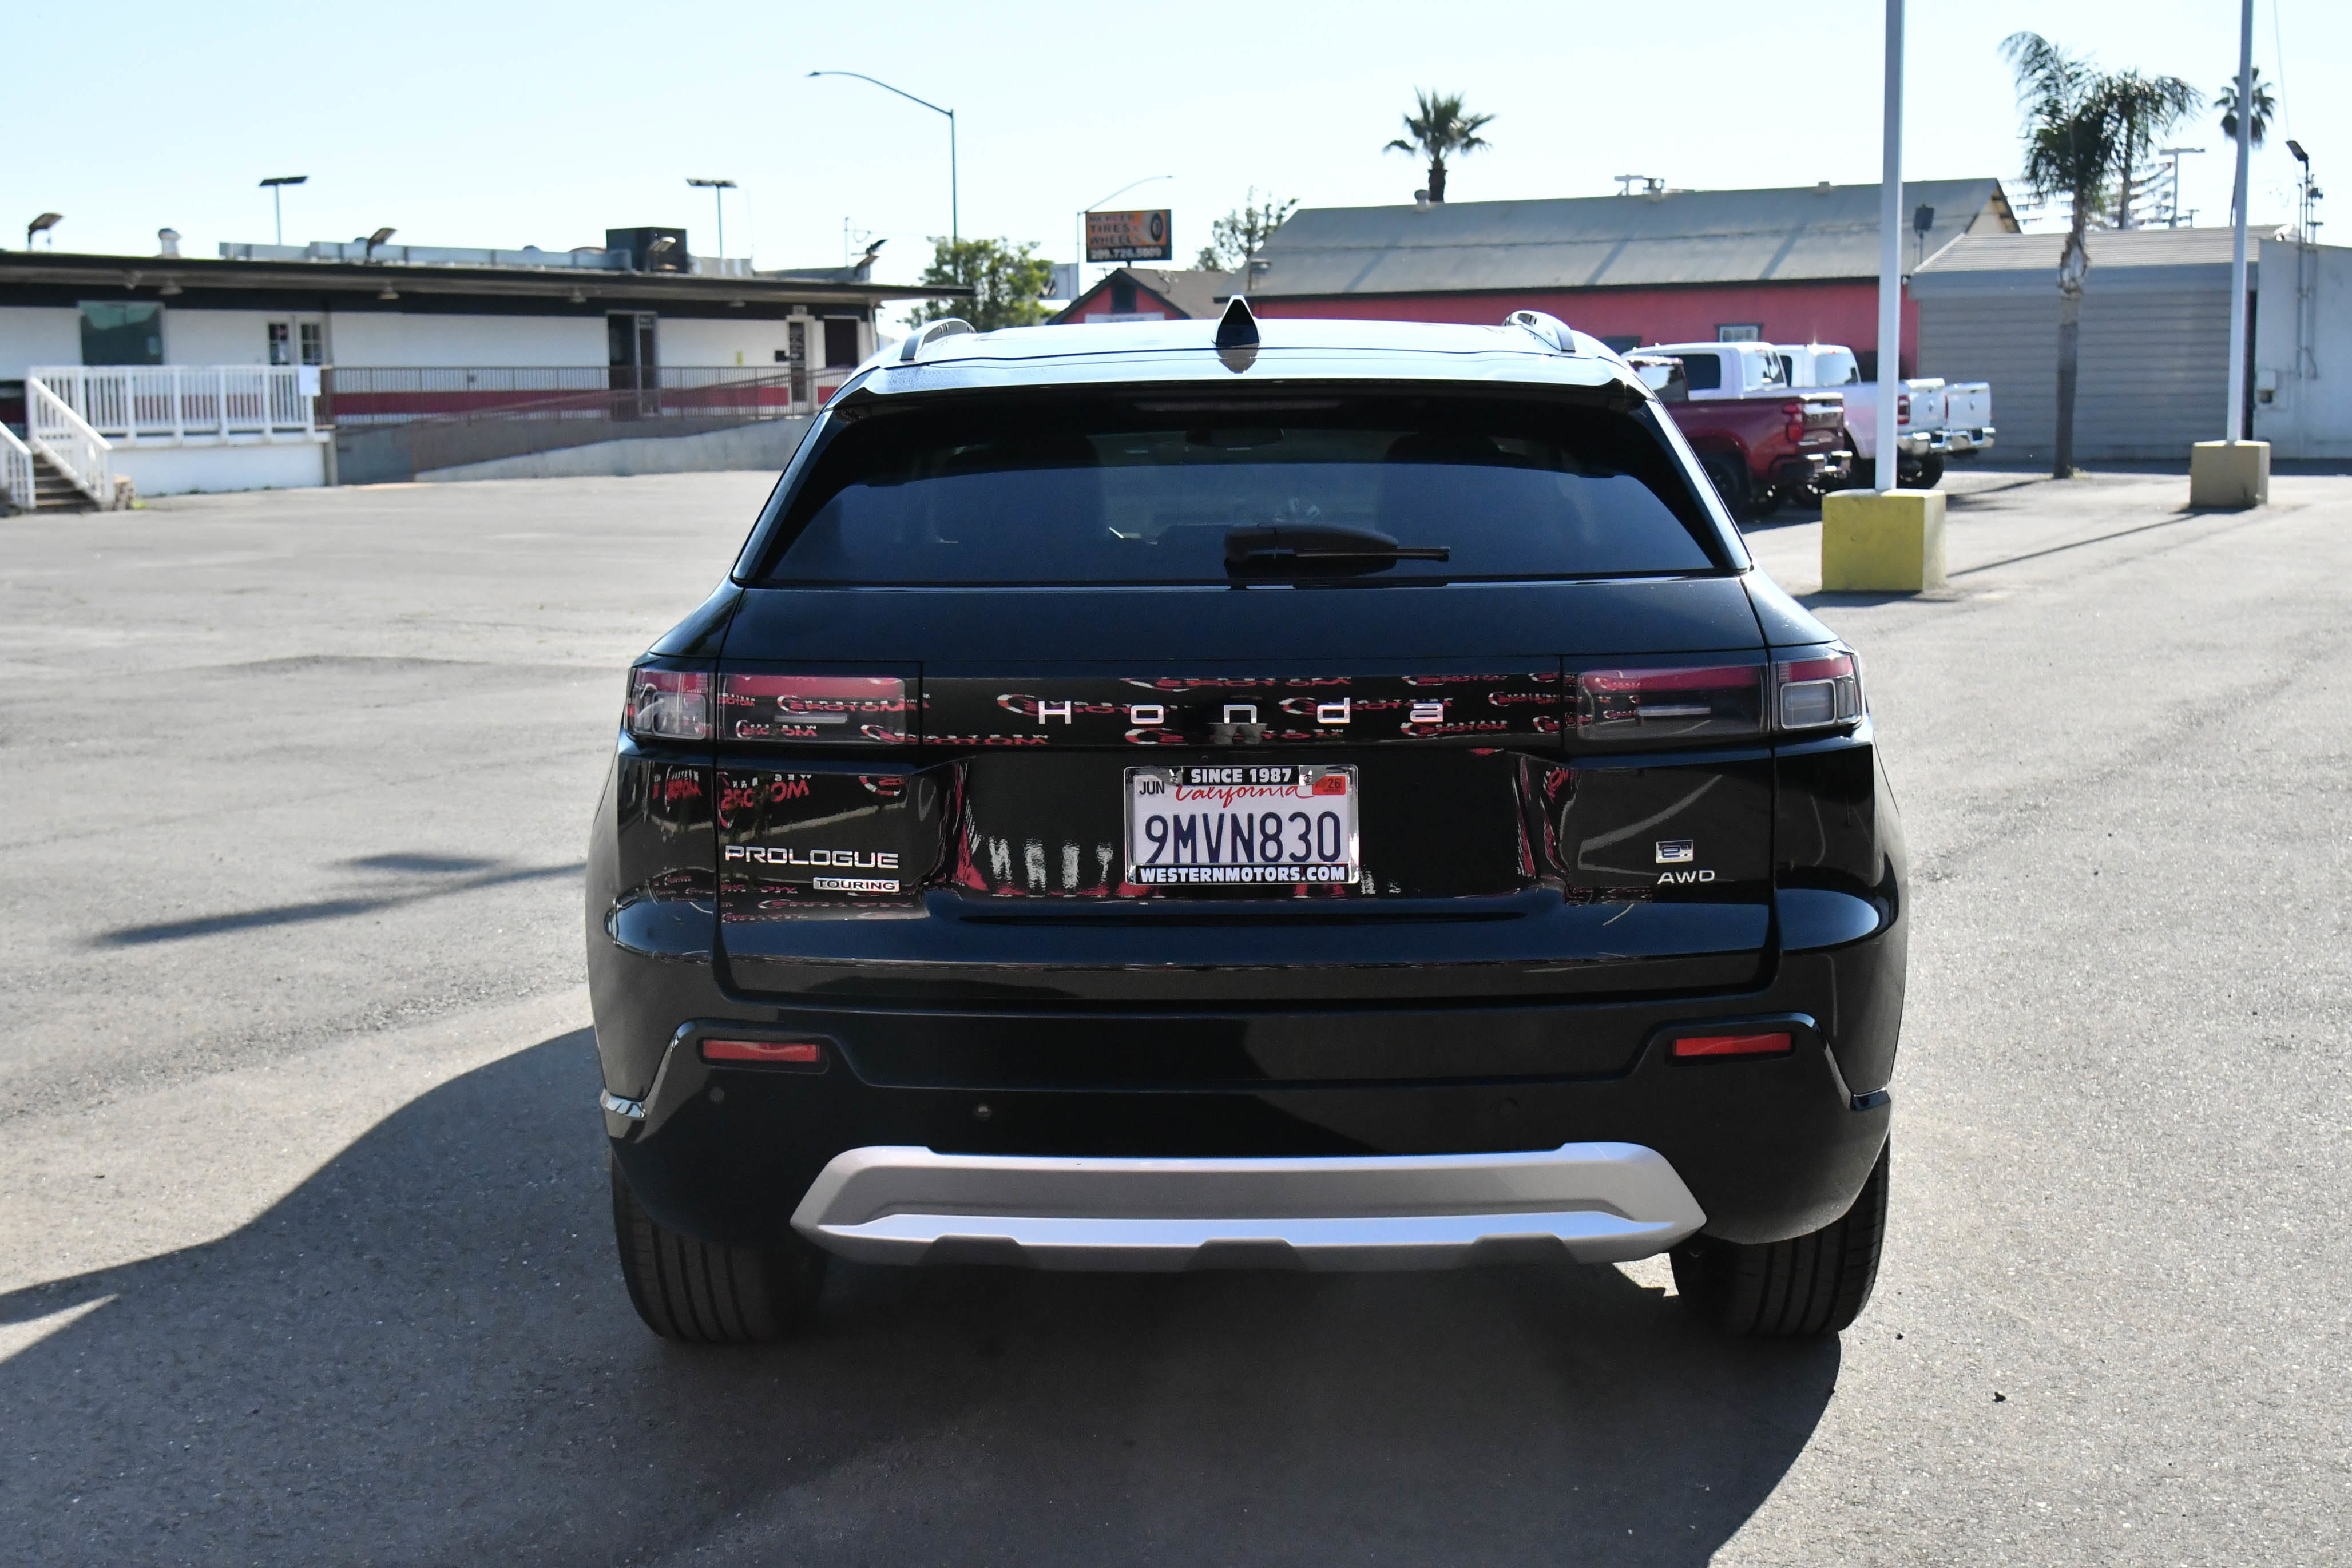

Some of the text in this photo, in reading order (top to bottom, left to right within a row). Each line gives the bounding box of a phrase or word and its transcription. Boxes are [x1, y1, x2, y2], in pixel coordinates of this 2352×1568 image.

[1090, 224, 1131, 233] TIRES
[1191, 768, 1292, 783] SINCE 1987
[1139, 781, 1165, 795] JUN
[1176, 785, 1314, 808] California
[1145, 811, 1341, 864] 9MVN830
[725, 845, 899, 869] PROLOGUE
[1140, 866, 1346, 883] WESTERNMOTORS.COM
[1657, 870, 1715, 885] AWD
[816, 880, 896, 891] TOURING
